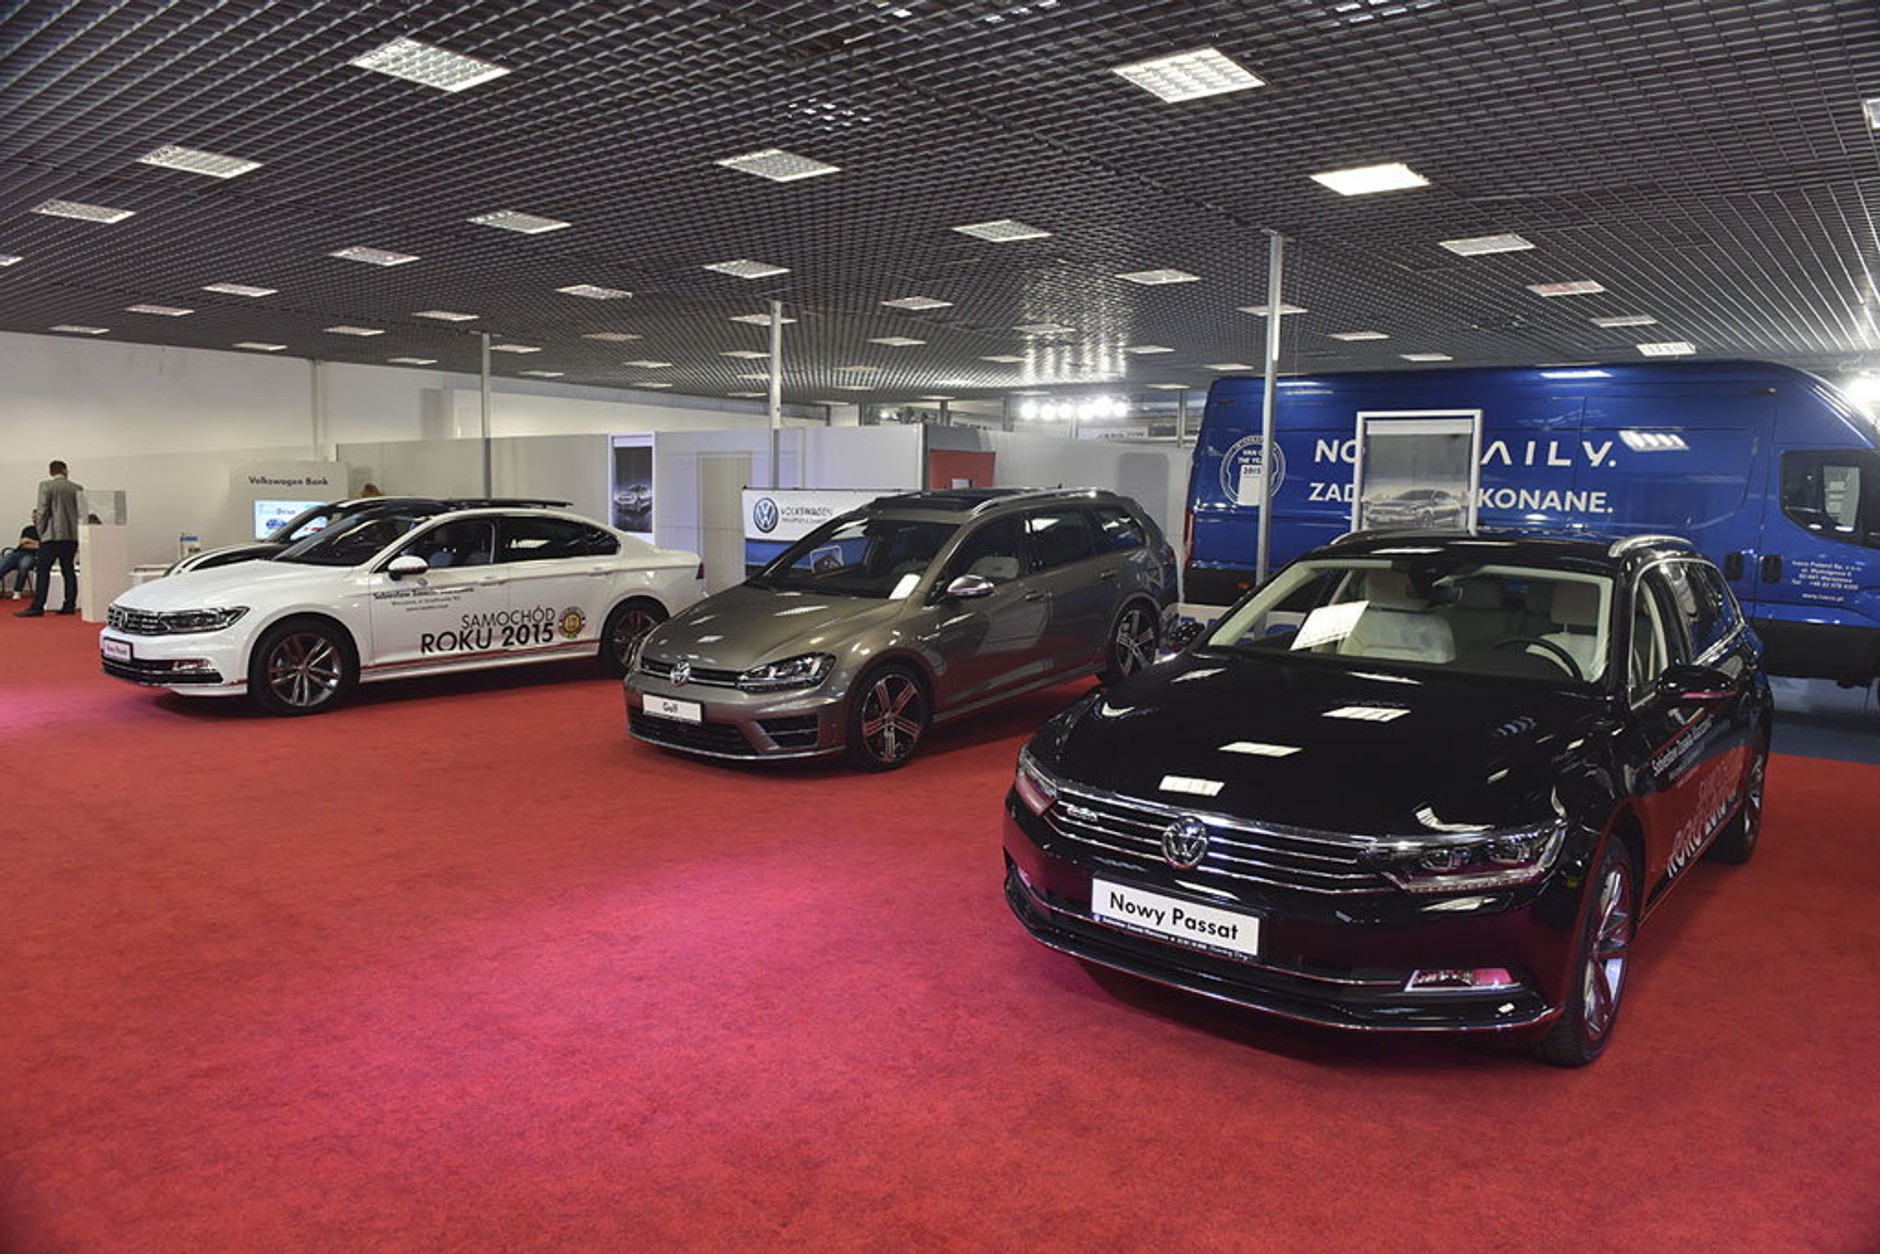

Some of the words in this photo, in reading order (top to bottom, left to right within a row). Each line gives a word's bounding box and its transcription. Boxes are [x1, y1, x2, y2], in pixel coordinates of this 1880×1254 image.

[1315, 439, 1357, 463] NO
[1480, 440, 1617, 468] AILY.
[248, 476, 303, 487] Volkswagen
[305, 477, 328, 486] Bank
[1308, 482, 1355, 502] ZAD
[1477, 487, 1613, 513] KONANE.
[461, 605, 556, 631] SAMOCHÓD
[421, 627, 493, 655] ROKU
[501, 622, 554, 648] 2015
[1110, 891, 1166, 926] Nowy
[1172, 908, 1239, 940] Passat
